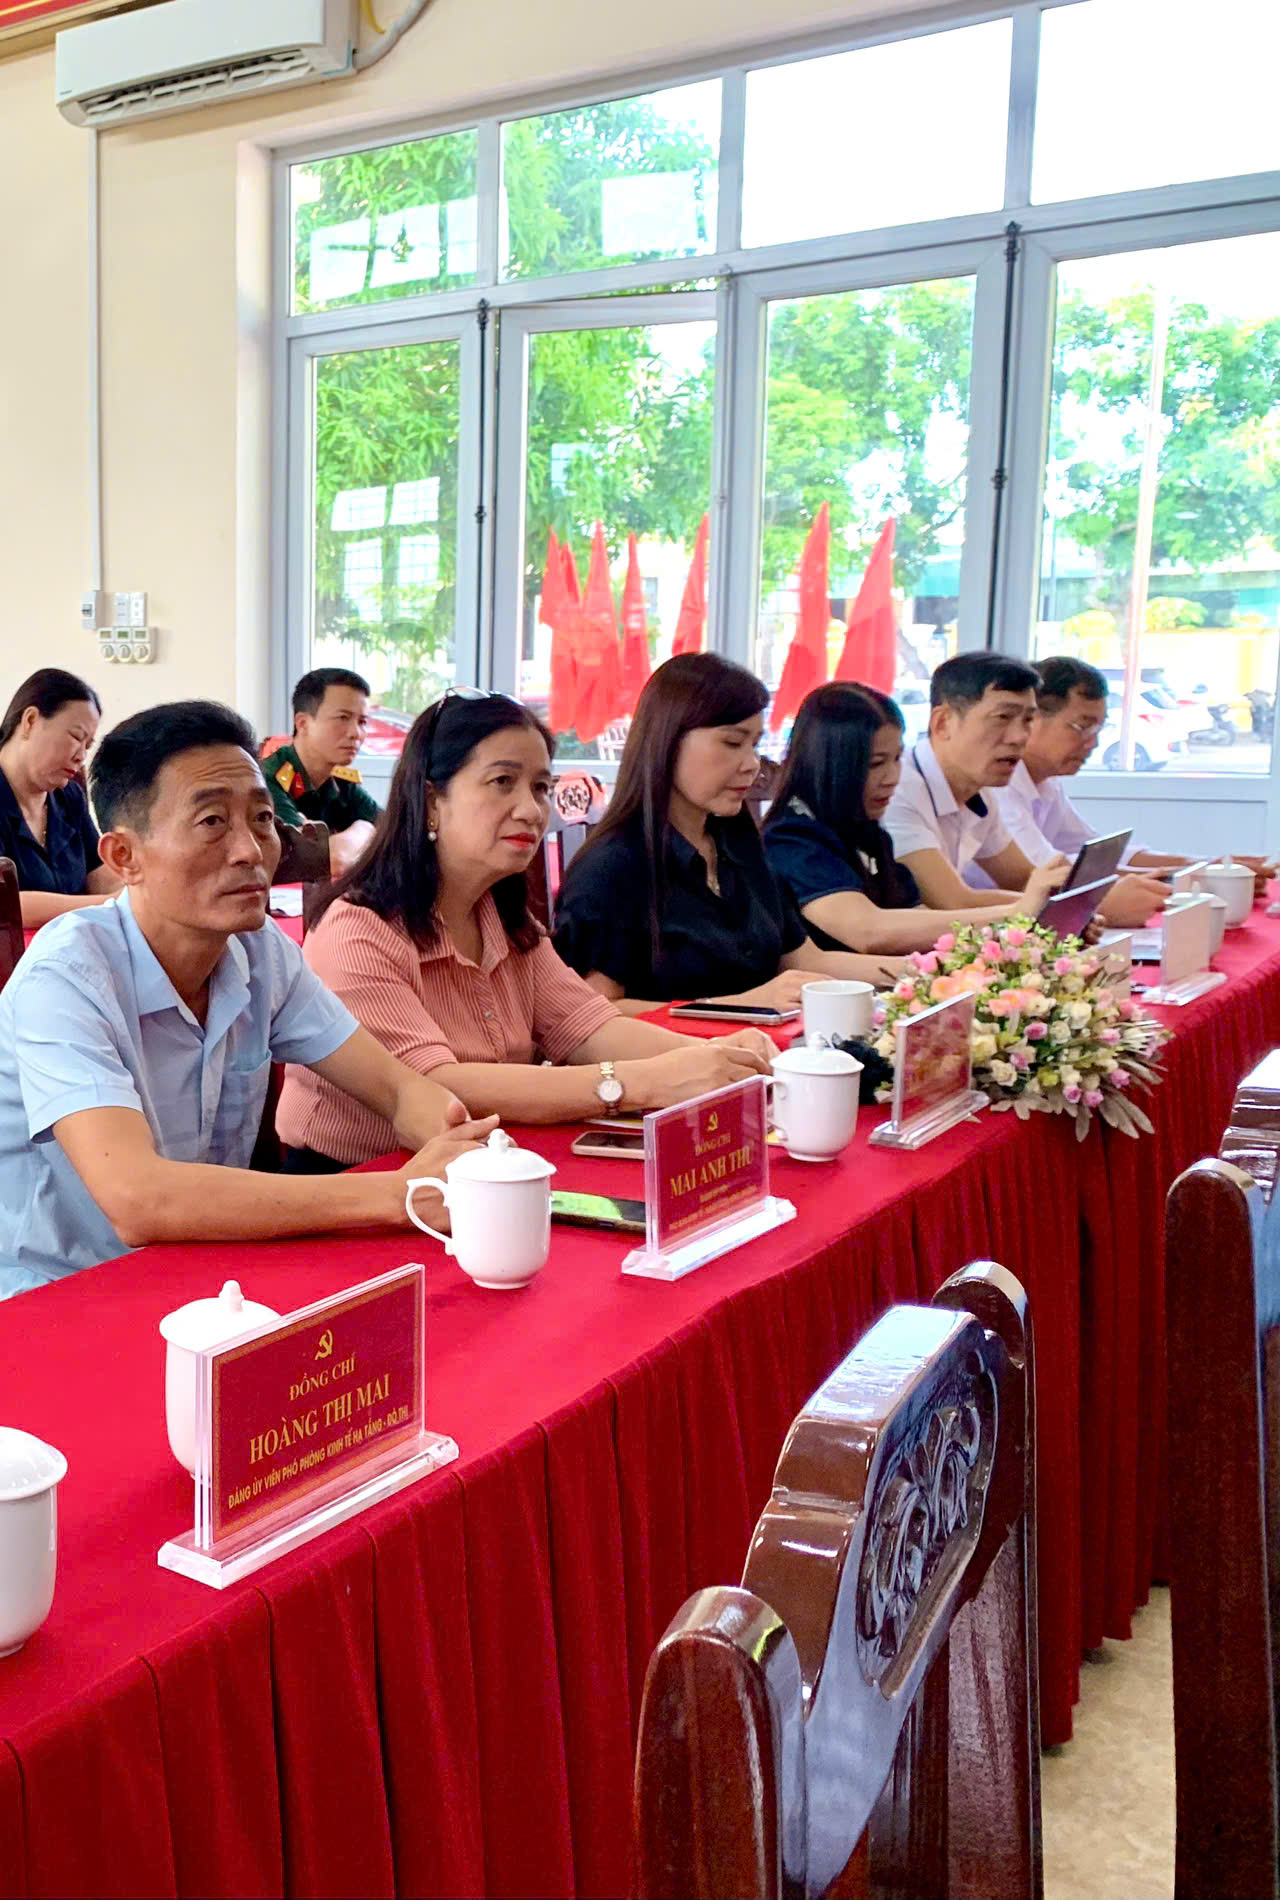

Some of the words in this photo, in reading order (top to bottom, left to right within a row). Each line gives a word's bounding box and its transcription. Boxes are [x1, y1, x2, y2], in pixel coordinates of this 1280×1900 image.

[670, 1168, 696, 1199] MAI
[701, 1156, 726, 1184] ANH
[289, 1370, 328, 1401] ĐỒNG
[331, 1352, 356, 1381] CHÍ
[249, 1409, 319, 1465] HOÀNG
[322, 1391, 353, 1428] THỊ
[356, 1373, 390, 1412] MAI
